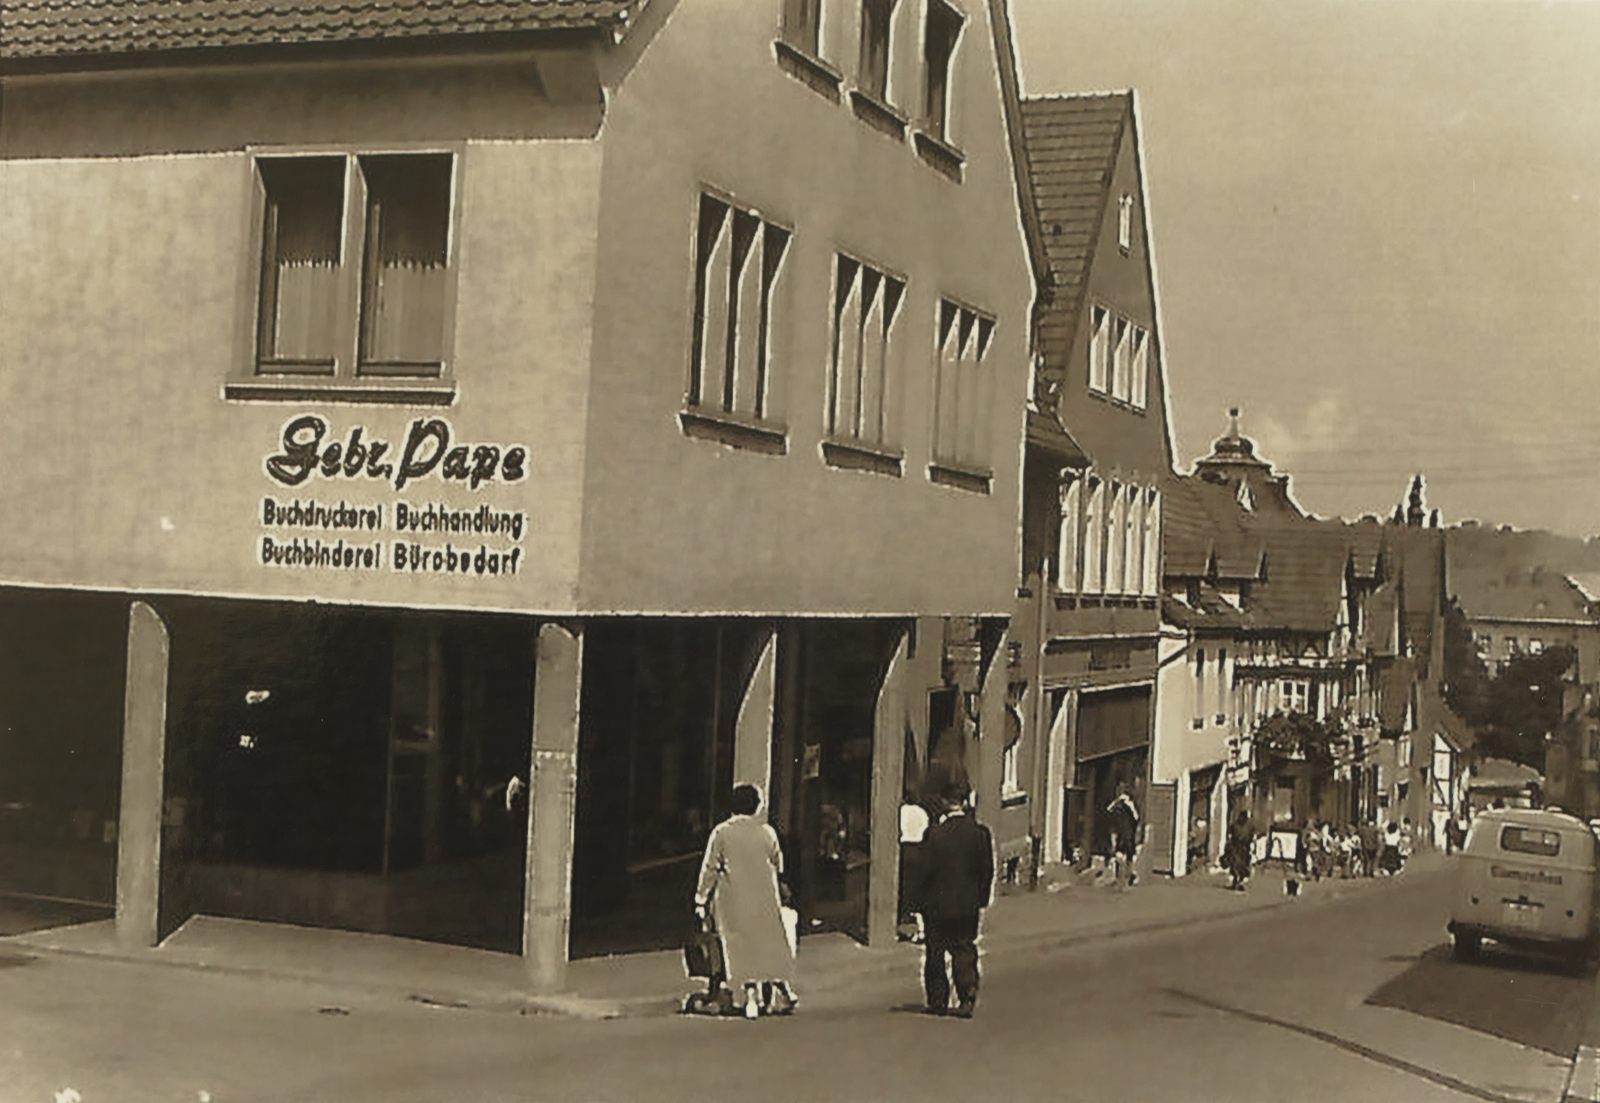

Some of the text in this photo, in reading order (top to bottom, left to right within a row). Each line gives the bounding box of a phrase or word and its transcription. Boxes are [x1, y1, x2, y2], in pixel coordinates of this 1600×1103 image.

[266, 416, 526, 490] Gebr. Pape
[263, 498, 523, 540] Buchdruckerei Buchhandlung
[262, 537, 520, 575] Buchbinderei Bürobedarf
